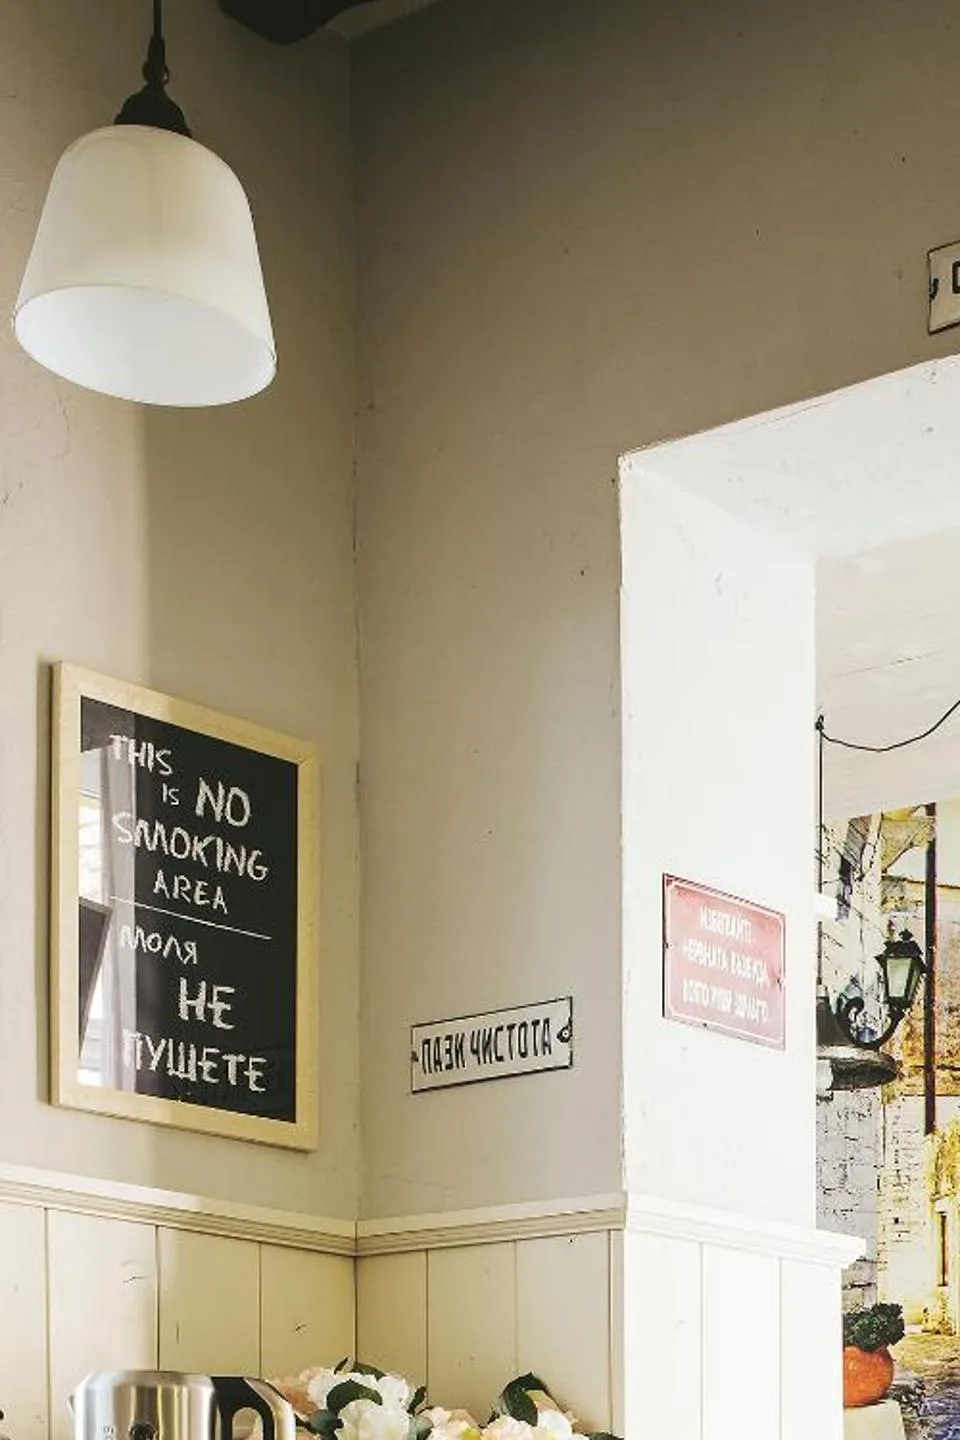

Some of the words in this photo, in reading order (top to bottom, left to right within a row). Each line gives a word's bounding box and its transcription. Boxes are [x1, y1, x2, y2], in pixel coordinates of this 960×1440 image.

[109, 734, 173, 776] THIS
[195, 776, 252, 827] NO
[111, 811, 268, 882] SMOKING
[152, 868, 229, 915] AREA
[120, 924, 198, 965] МОЛЯ
[178, 976, 236, 1030] НЕ
[122, 1028, 267, 1093] ПУШЕТЕ
[422, 1032, 466, 1075] ПАЗИ
[470, 1017, 552, 1066] ЧИСТОТА
